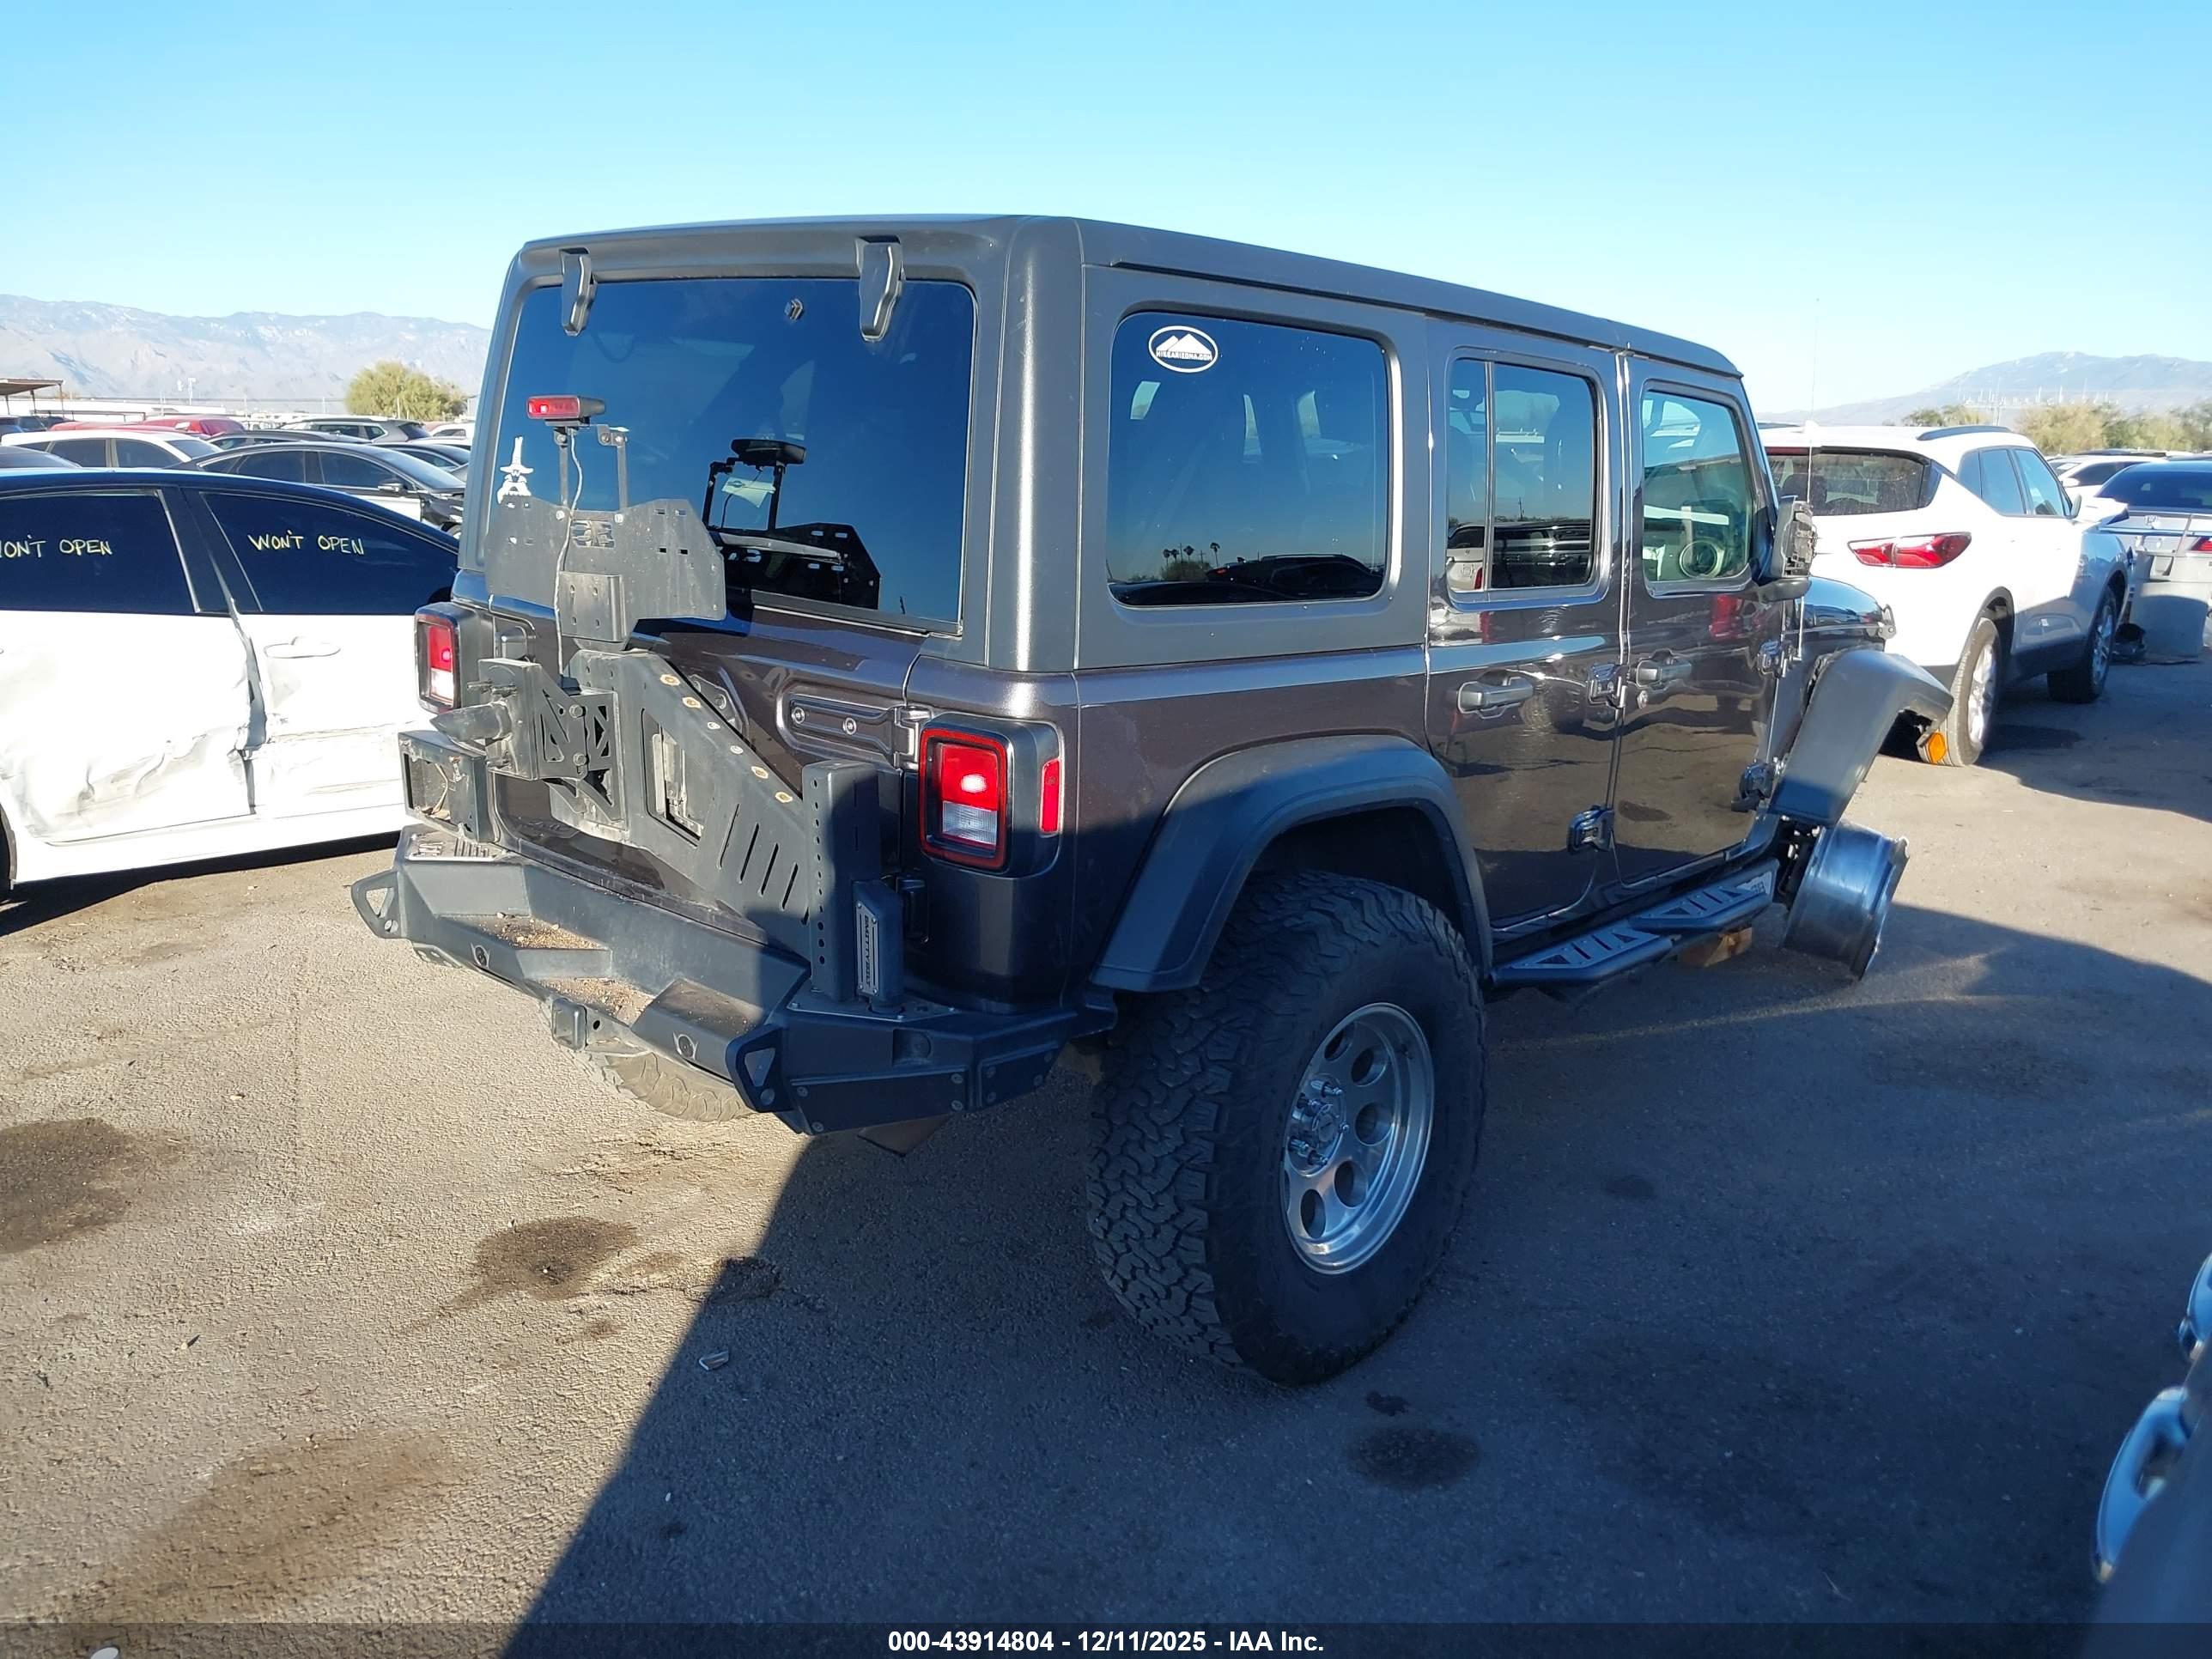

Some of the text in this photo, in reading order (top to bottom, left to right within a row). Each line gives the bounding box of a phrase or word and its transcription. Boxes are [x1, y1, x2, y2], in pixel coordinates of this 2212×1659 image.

[0, 534, 112, 558] ON'T OPEN
[246, 529, 364, 555] WON'T OPEN
